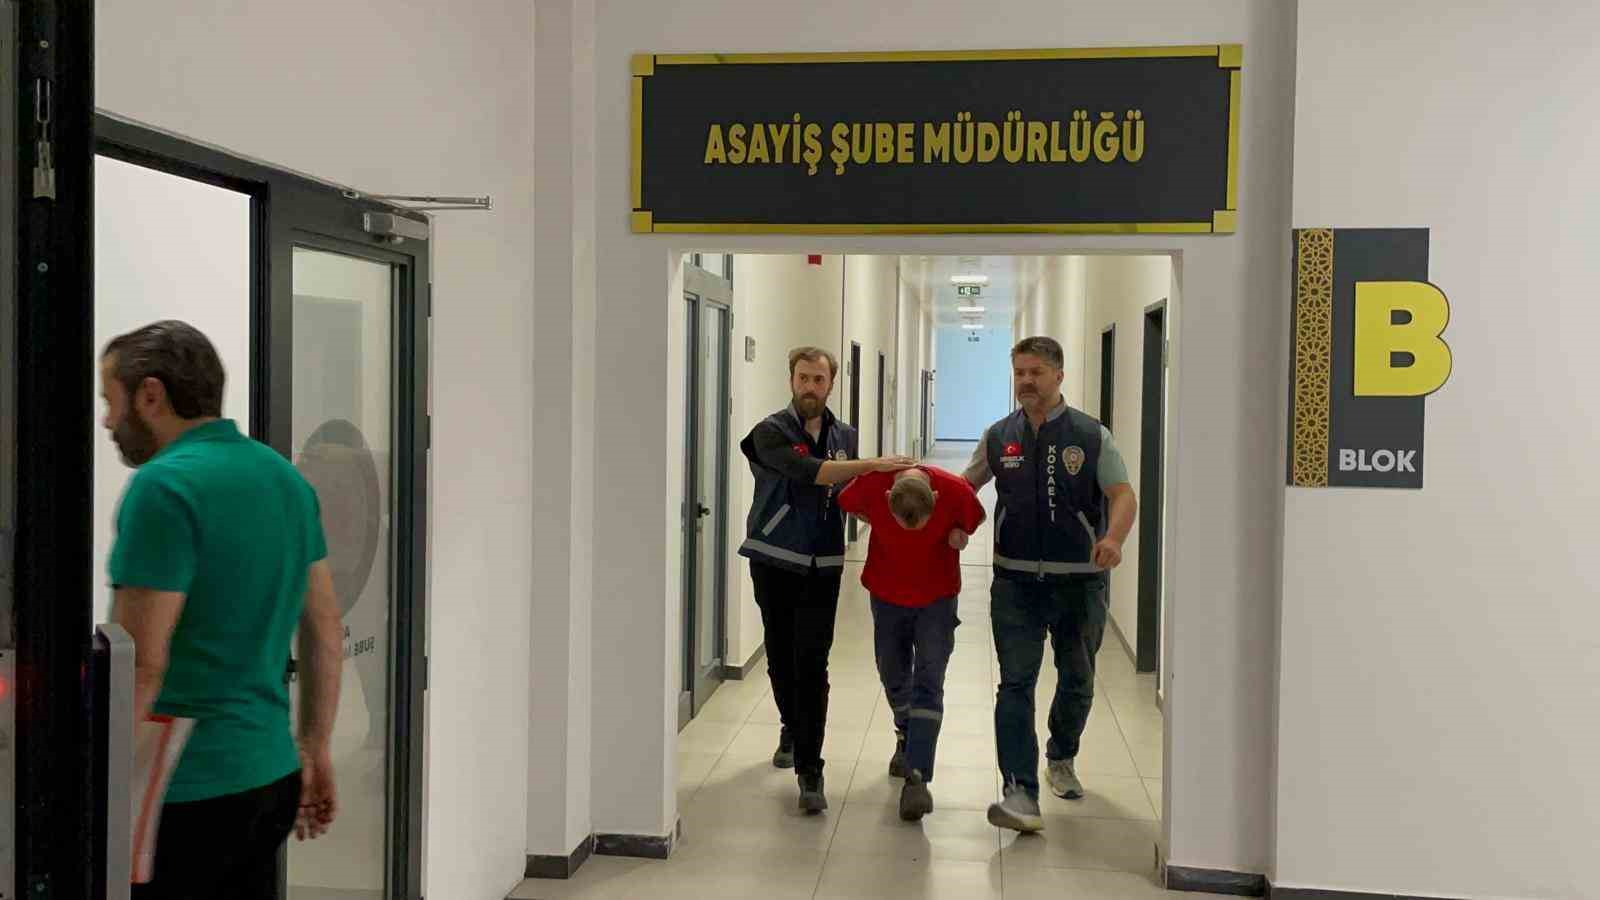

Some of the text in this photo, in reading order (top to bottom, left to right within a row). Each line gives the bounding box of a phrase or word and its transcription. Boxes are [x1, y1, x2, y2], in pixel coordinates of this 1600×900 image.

[704, 110, 1145, 176] ASAYİŞ ŞUBE MÜDÜRLÜĞÜ
[1353, 281, 1452, 397] B
[1339, 449, 1417, 473] BLOK
